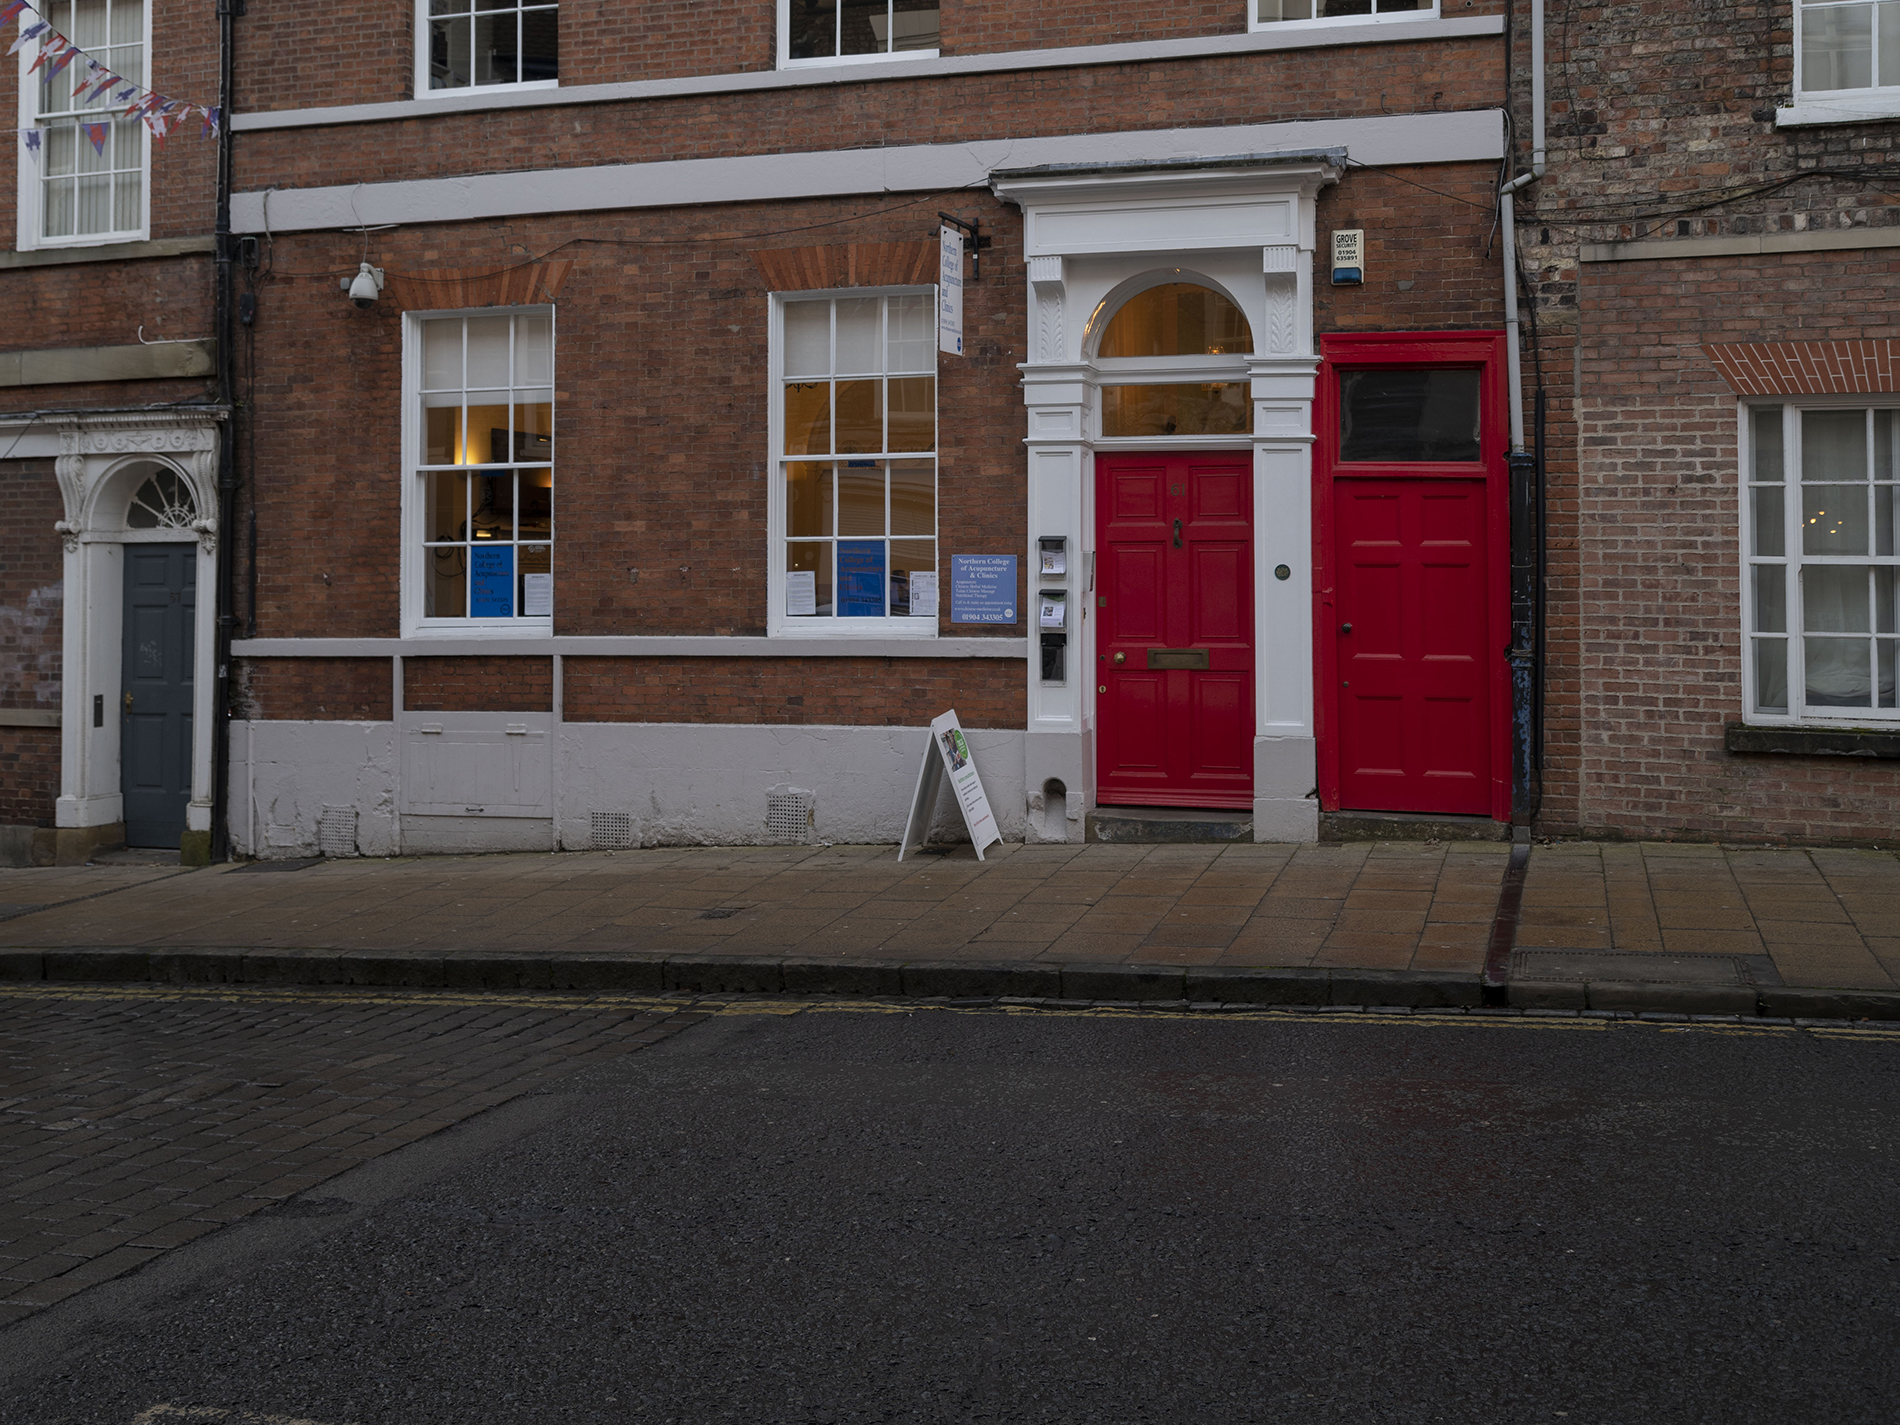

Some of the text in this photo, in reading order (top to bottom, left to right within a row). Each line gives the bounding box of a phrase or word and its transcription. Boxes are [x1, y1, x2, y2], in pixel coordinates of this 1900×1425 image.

[1336, 234, 1357, 243] GROVE
[942, 240, 957, 256] Northern
[942, 255, 954, 272] College
[942, 300, 953, 314] Clinics
[1171, 483, 1185, 496] 61
[474, 561, 495, 569] College
[474, 570, 510, 579] Acupuncture
[169, 592, 181, 603] 57
